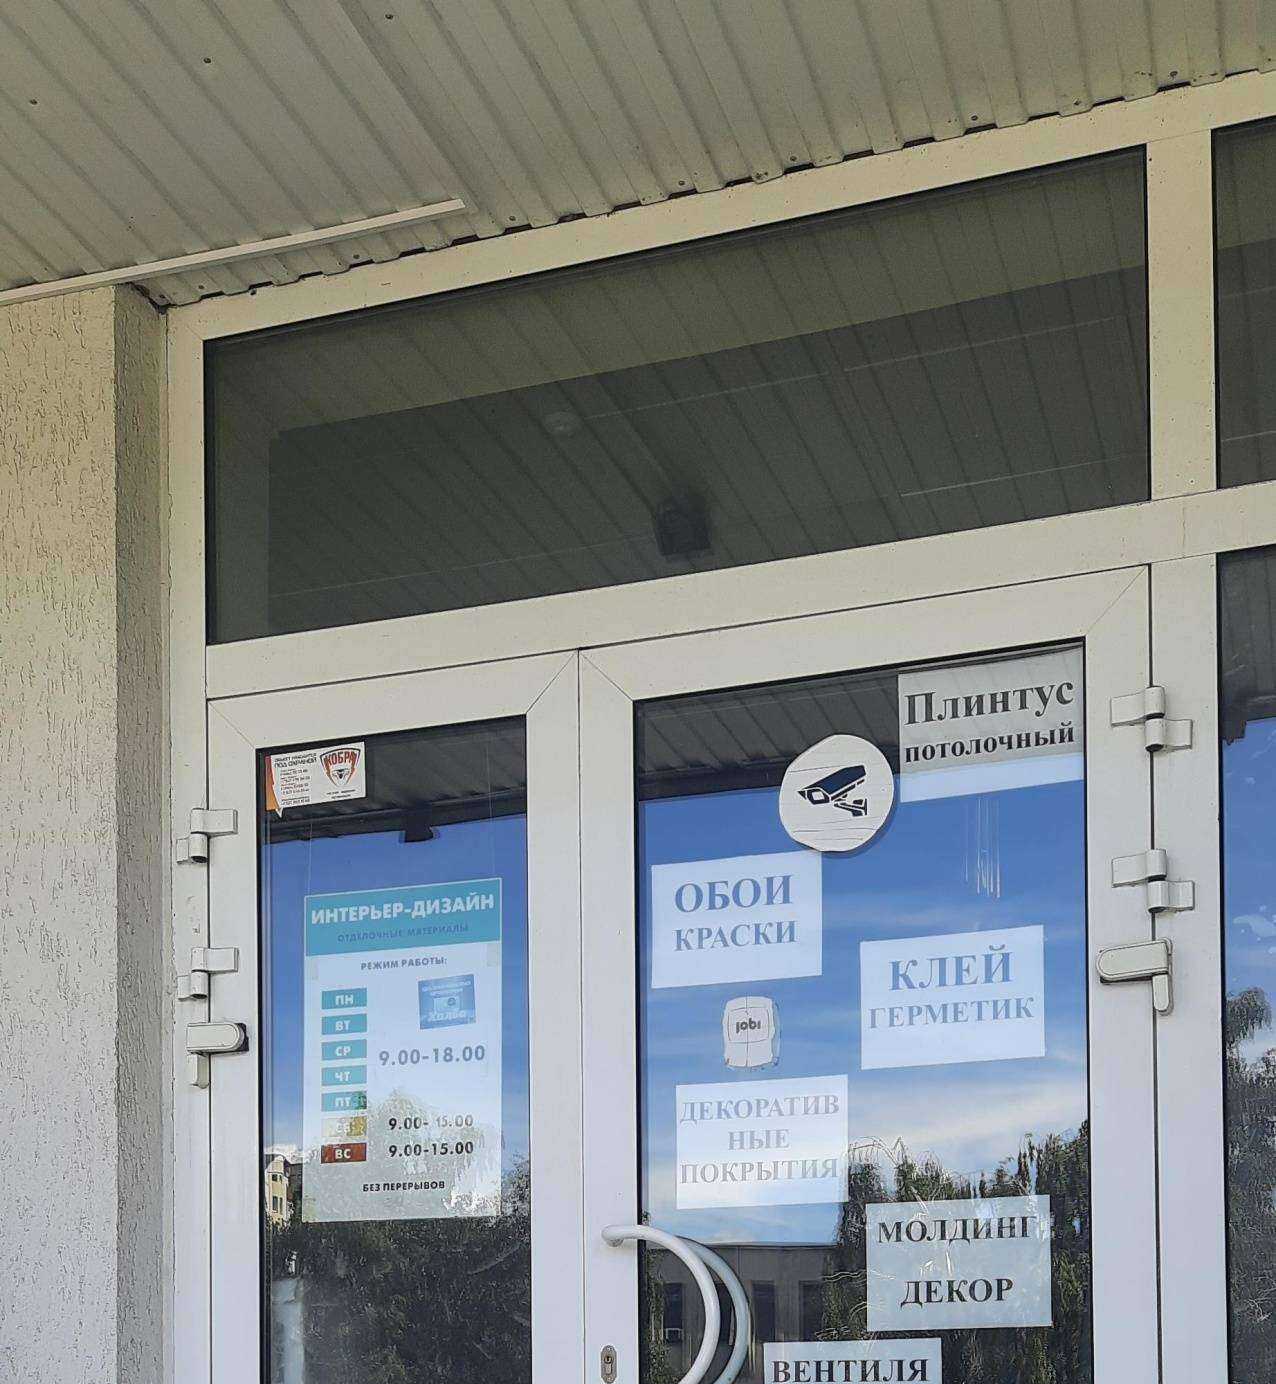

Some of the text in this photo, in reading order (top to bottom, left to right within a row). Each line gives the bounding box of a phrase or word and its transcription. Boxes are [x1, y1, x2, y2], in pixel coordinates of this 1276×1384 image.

[904, 680, 1075, 726] Плинтус
[904, 721, 1076, 764] потолочный
[674, 874, 793, 913] ОБОИ
[311, 892, 495, 925] ИНТЕРЬЕР-ДИЗАЙН
[337, 922, 469, 943] ОТДЕЛОЧНЫЕ МАТЕРИАЛЫ
[673, 920, 799, 952] КРАСКИ
[360, 957, 448, 971] РЕЖИМ РАБОТЫ:
[888, 943, 1015, 991] КЛЕЙ
[335, 994, 354, 1006] ПН
[868, 996, 1036, 1030] ГЕРМЕТИК
[335, 1020, 351, 1032] ВТ
[735, 1017, 761, 1034] jobi
[335, 1046, 351, 1057] СР
[379, 1045, 486, 1066] 9.00-18.00
[335, 1071, 351, 1082] ЧТ
[335, 1097, 351, 1108] ПТ
[679, 1093, 840, 1125] ДЕКОРАТИВ
[388, 1141, 474, 1158] 9.00-15.00
[727, 1128, 790, 1151] НЫЕ
[335, 1148, 352, 1160] ВС
[679, 1158, 839, 1185] ПОКРЫТИЯ
[362, 1181, 446, 1192] БЕЗ ПЕРЕРЫВОВ
[877, 1215, 1037, 1245] МОЛДИНГ
[900, 1277, 1014, 1308] ДЕКОР
[771, 1358, 929, 1384] ВЕНТИЛЯ
